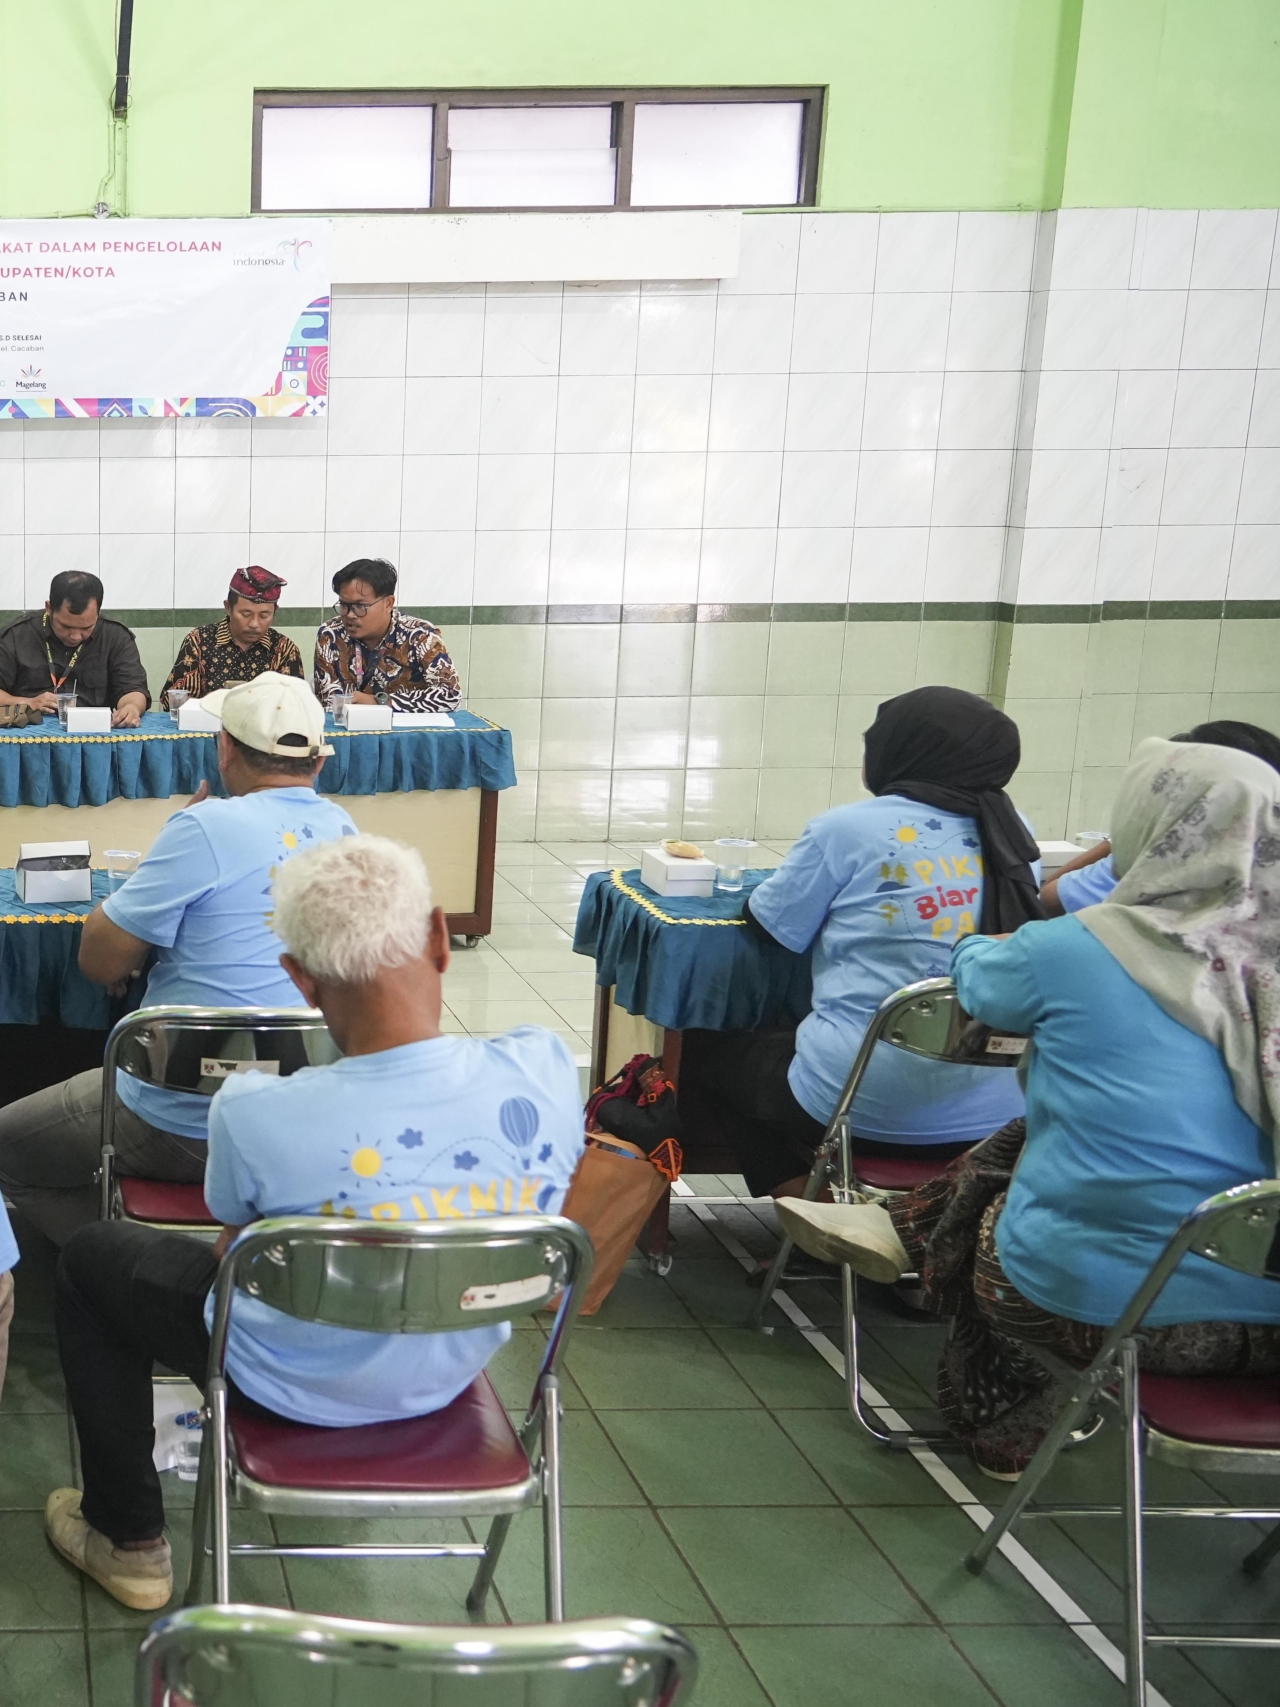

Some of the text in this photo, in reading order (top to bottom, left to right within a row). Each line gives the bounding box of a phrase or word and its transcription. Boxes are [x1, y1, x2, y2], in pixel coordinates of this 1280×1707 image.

[39, 242, 97, 254] DALAM
[102, 241, 222, 253] PENGELOLAAN
[232, 257, 286, 267] indonesia
[15, 381, 47, 390] Magelang
[913, 885, 979, 920] Biar
[931, 911, 976, 940] PA
[369, 1176, 543, 1222] PIKNIK
